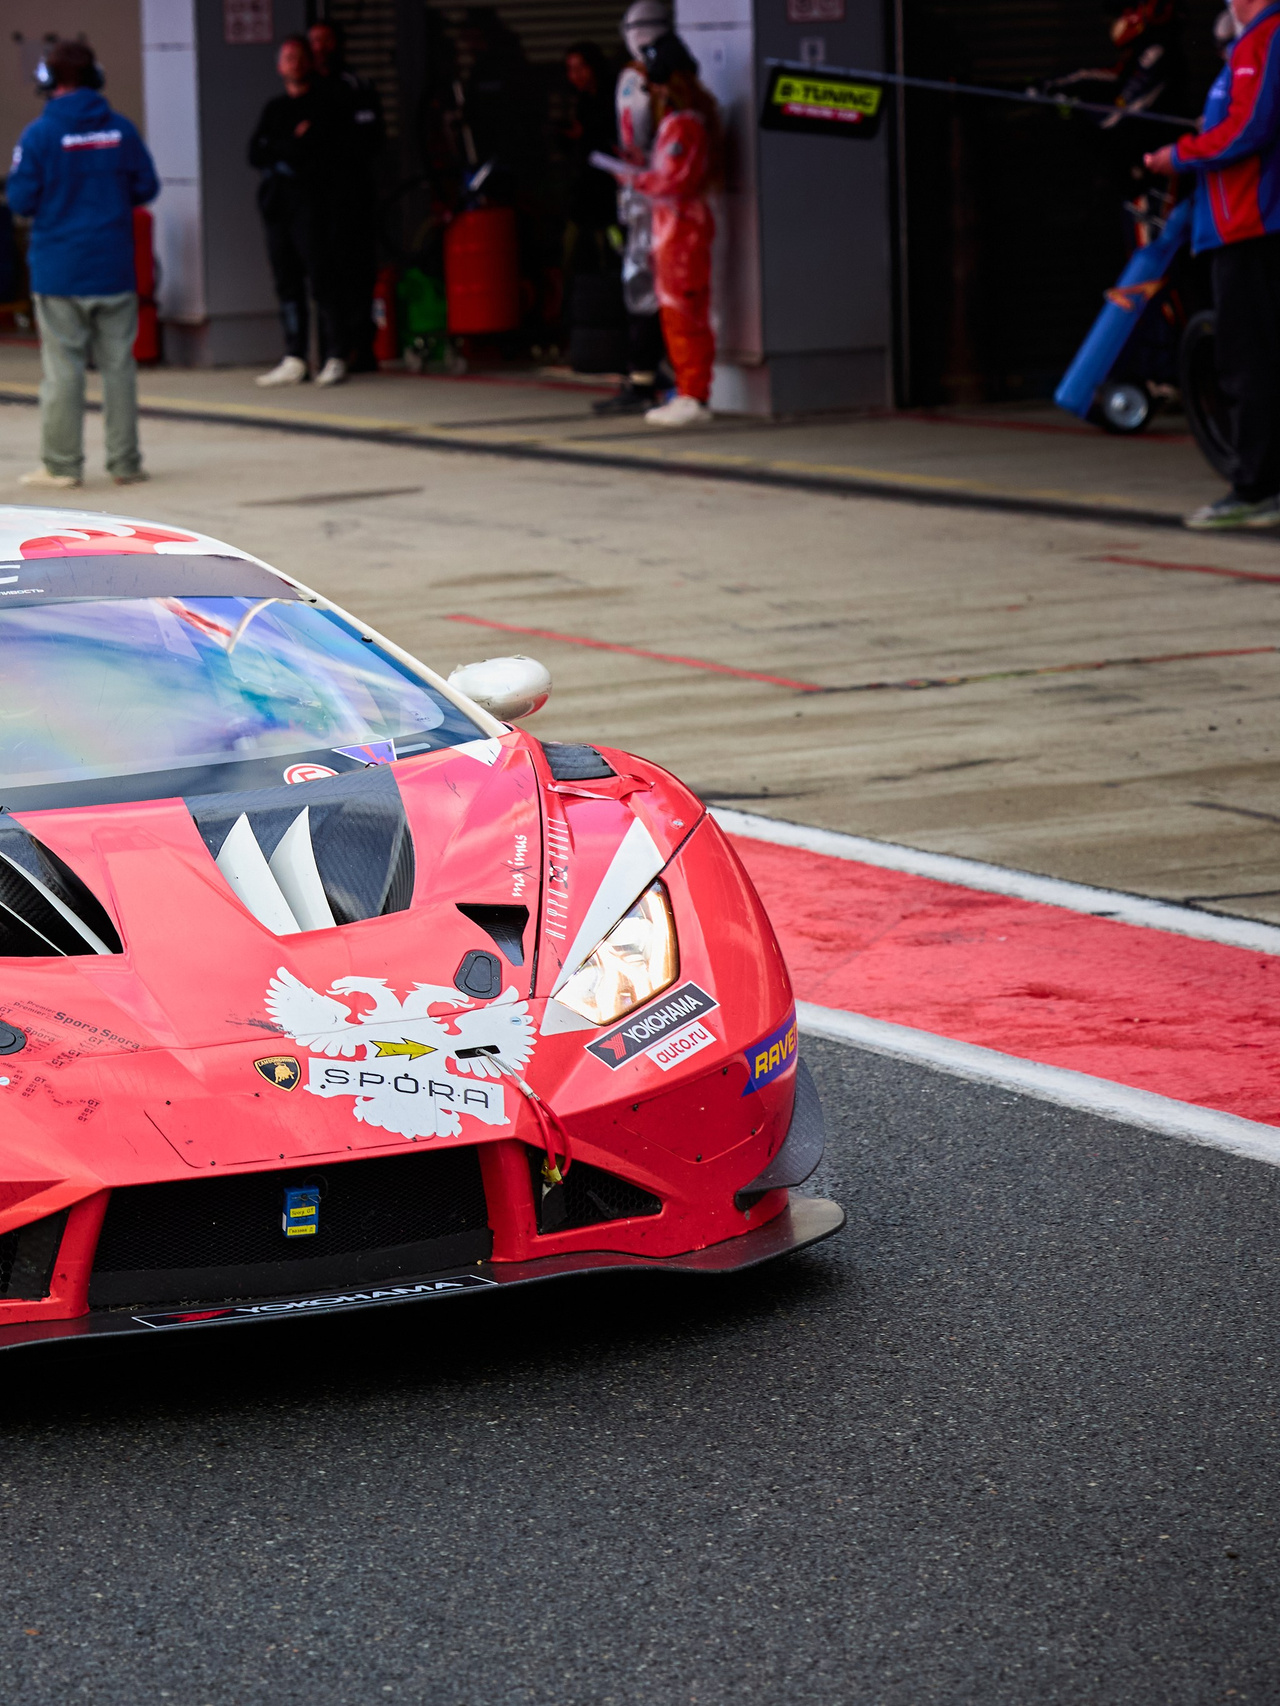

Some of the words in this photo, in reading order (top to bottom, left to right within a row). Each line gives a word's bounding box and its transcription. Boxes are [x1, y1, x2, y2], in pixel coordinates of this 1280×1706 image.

[54, 1011, 98, 1034] Spora
[622, 993, 704, 1044] YOKOHAMA
[100, 1029, 140, 1049] Spora
[656, 1026, 709, 1065] auto.ru
[236, 1279, 463, 1314] YOKOHAMA
